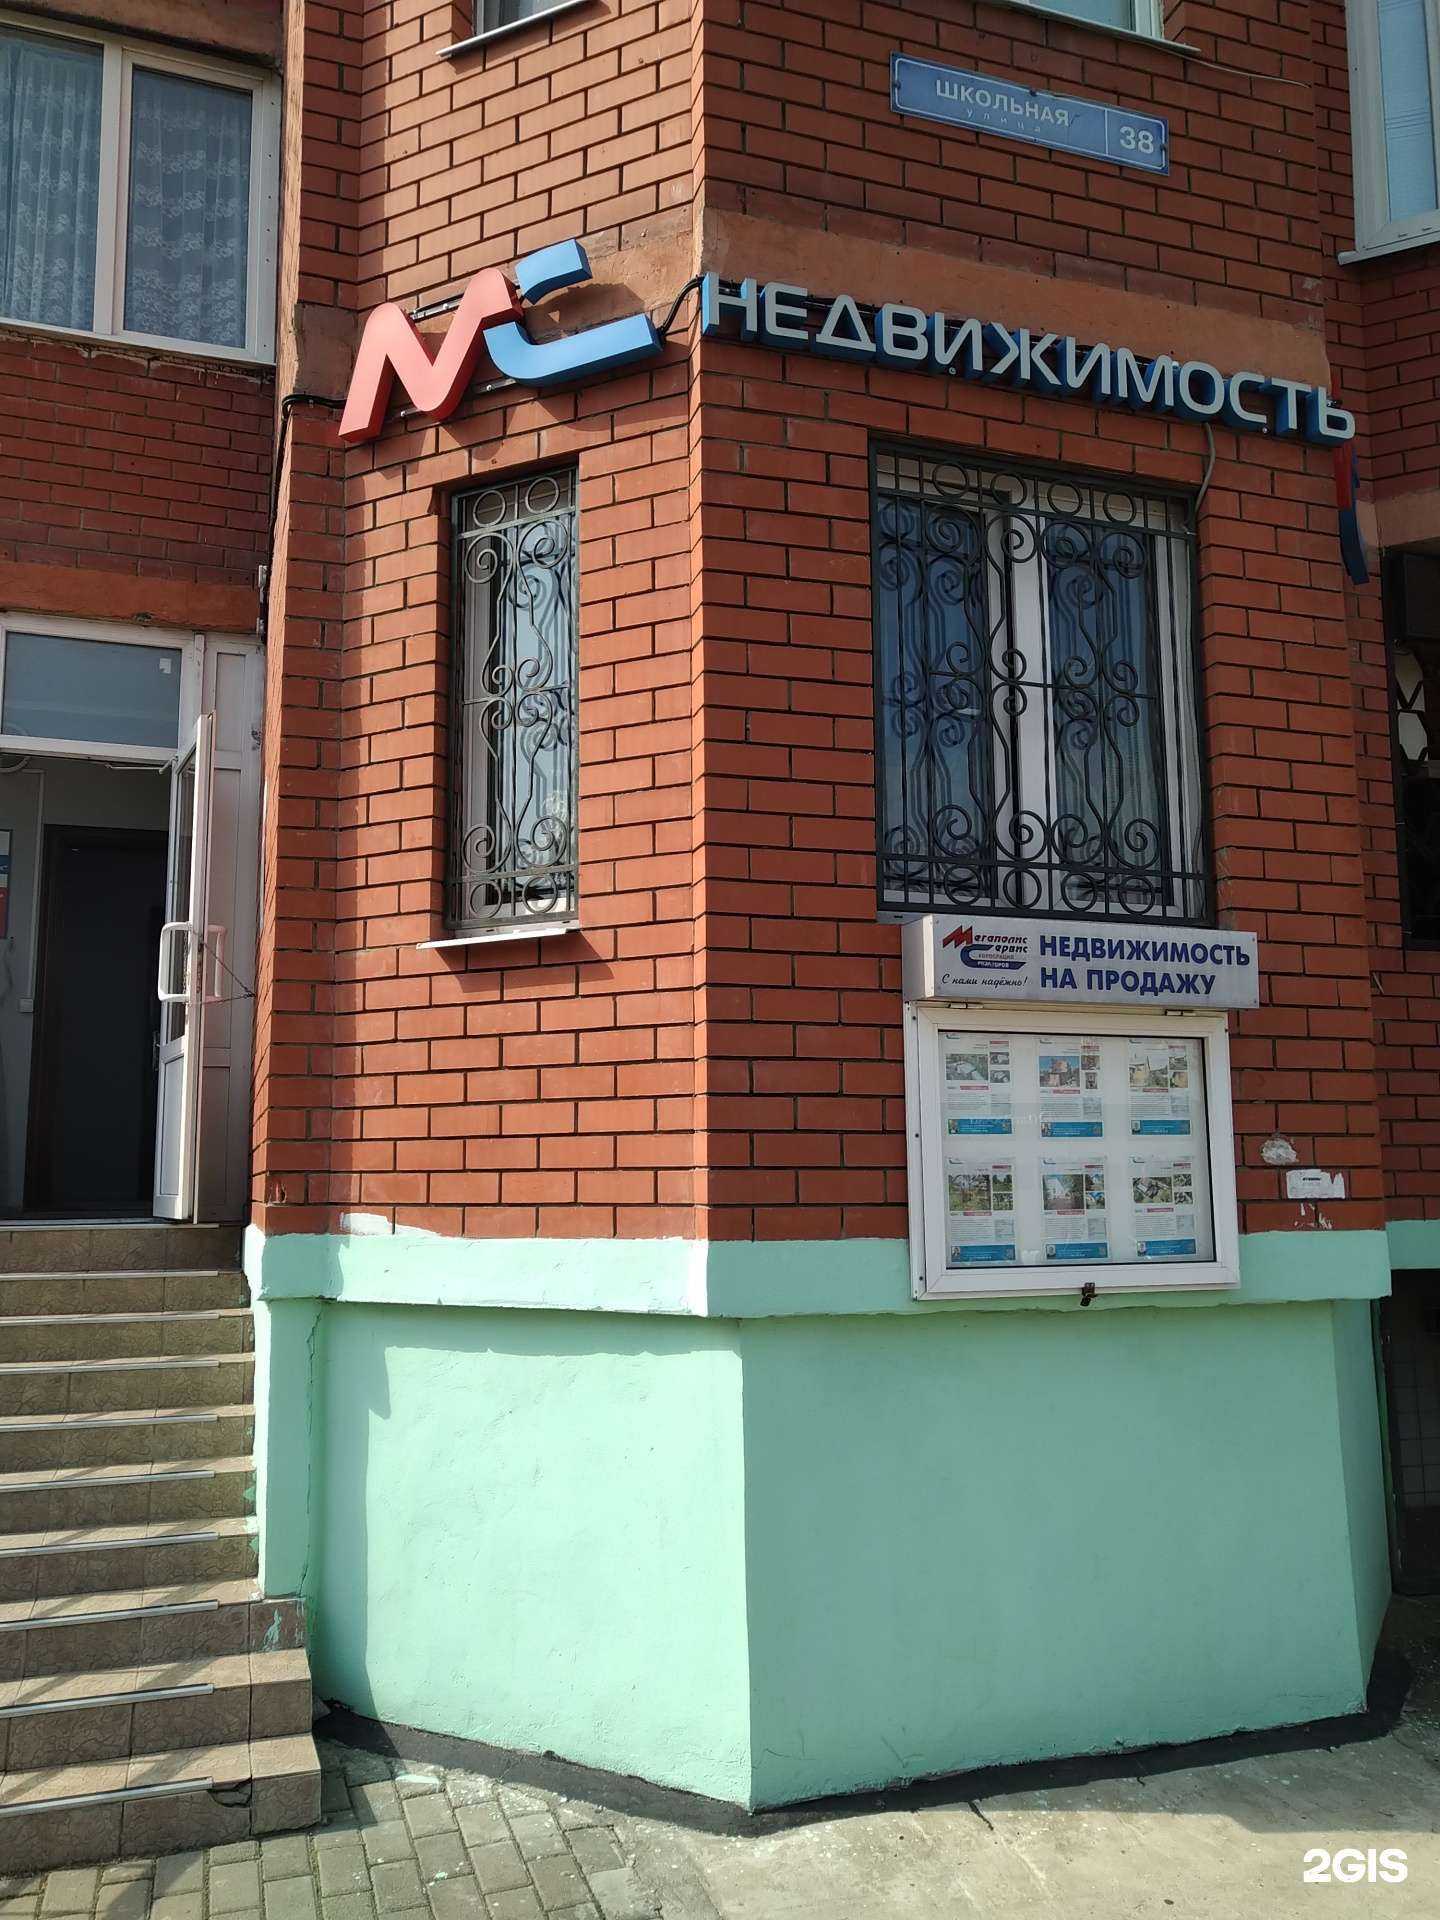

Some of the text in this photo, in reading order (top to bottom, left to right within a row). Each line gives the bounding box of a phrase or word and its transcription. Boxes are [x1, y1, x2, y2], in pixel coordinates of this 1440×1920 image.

[936, 79, 1069, 127] ШКОЛЬНАЯ
[966, 107, 1041, 132] улица
[1119, 125, 1154, 154] 38
[702, 272, 1356, 443] НЕДВИЖИМОСТЬ
[1039, 935, 1250, 966] НЕДВИЖИМОСТЬ
[941, 973, 950, 984] С
[981, 976, 1028, 989] надёжно!
[1040, 967, 1217, 996] НА ПРОДАЖУ
